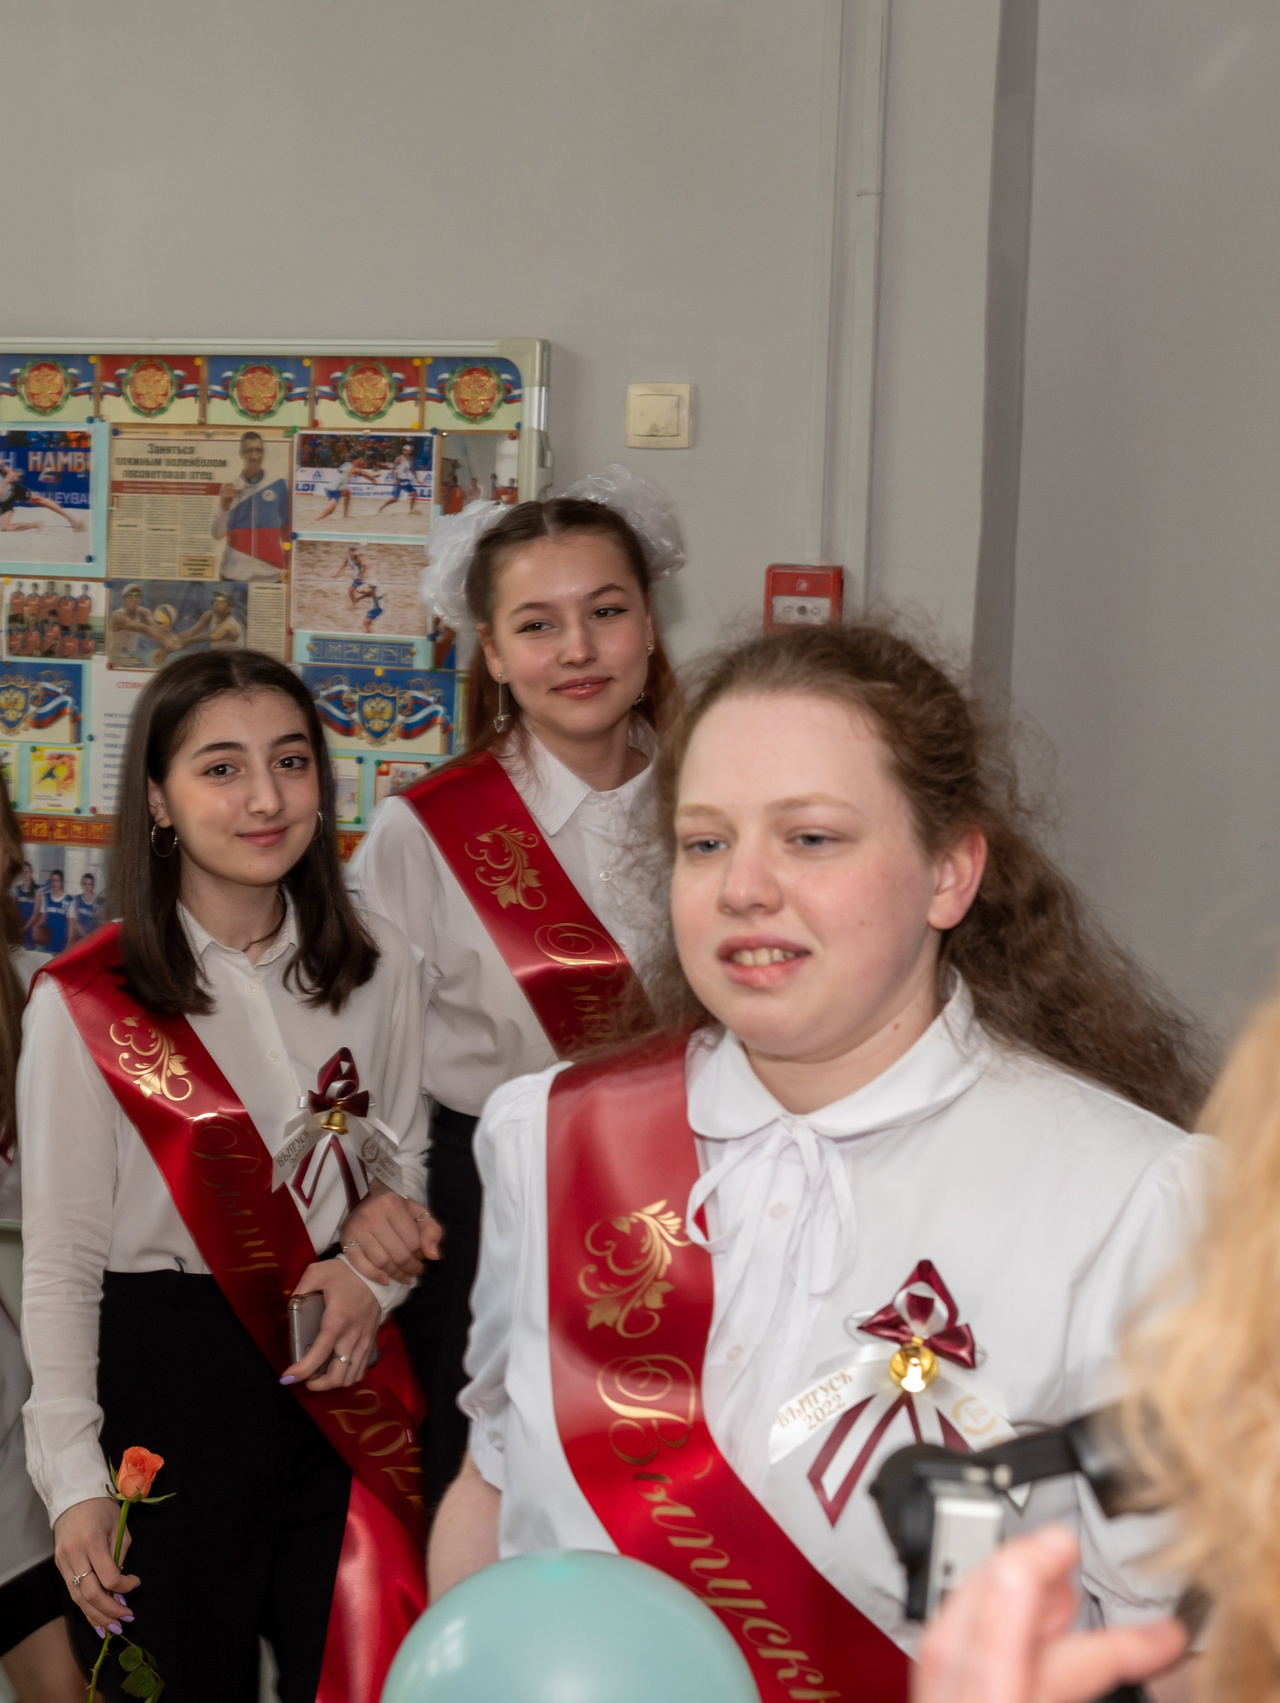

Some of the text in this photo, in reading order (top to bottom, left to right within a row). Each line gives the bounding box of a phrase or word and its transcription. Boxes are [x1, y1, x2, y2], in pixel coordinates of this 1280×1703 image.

[147, 443, 195, 455] Заняться
[122, 470, 186, 480] посоветовал
[775, 1370, 854, 1429] ВЫПУСК
[803, 1394, 846, 1431] 2022
